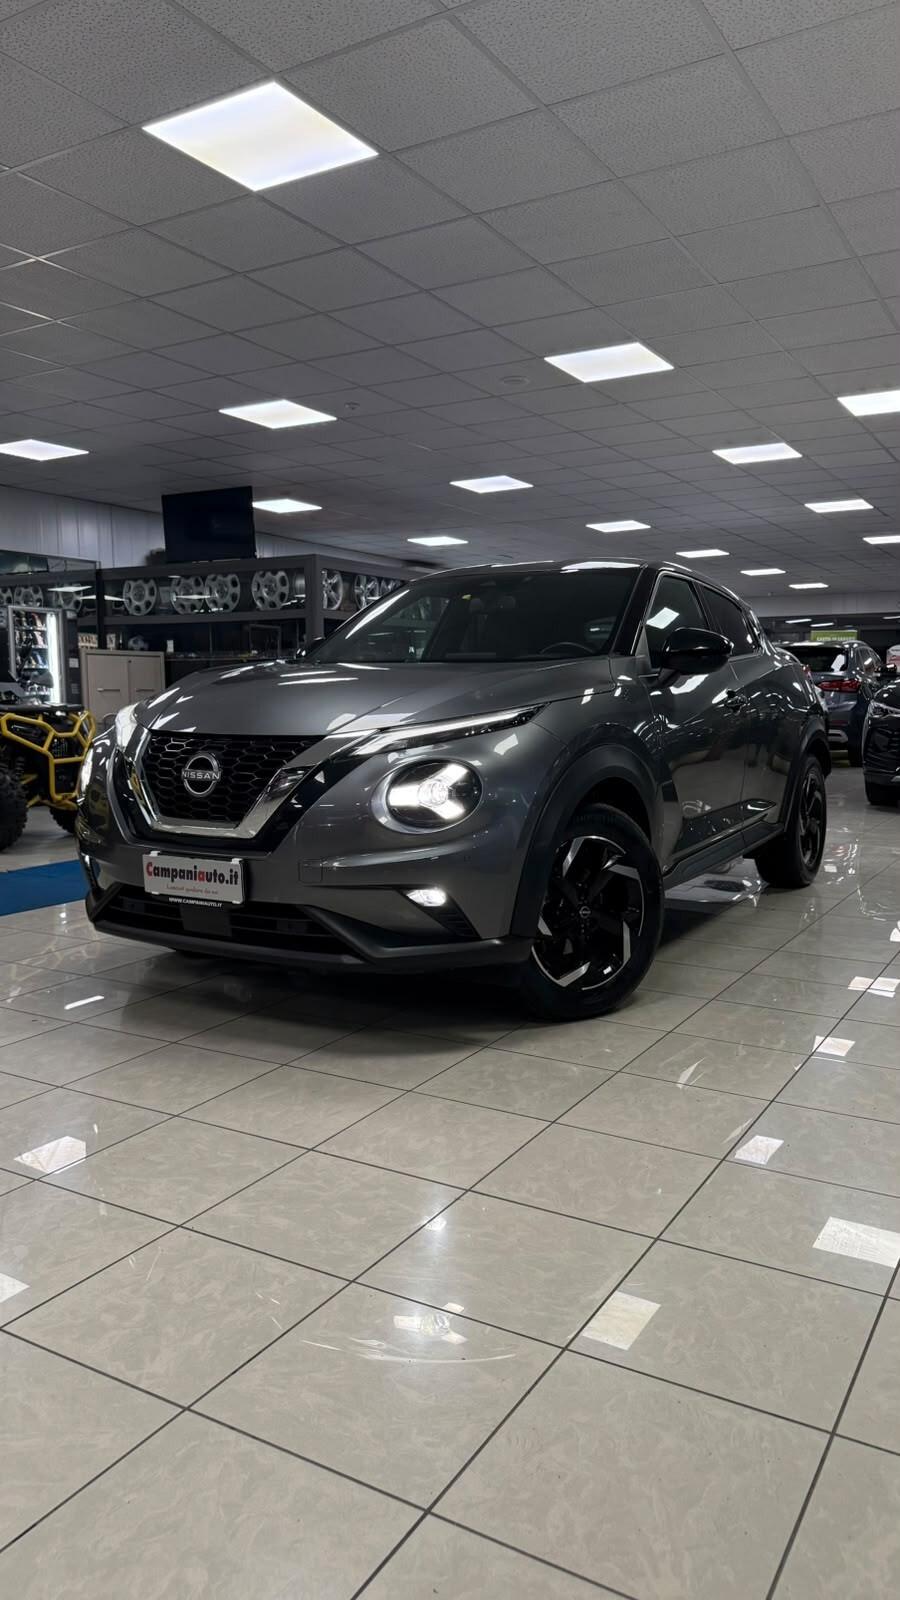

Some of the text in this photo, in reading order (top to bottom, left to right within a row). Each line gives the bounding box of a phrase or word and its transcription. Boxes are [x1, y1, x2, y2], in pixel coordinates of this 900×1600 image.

[182, 771, 220, 780] NISSAN
[146, 862, 238, 885] Campaniauto.it
[169, 897, 222, 908] WWW.CAMPANIAUTO.IT
